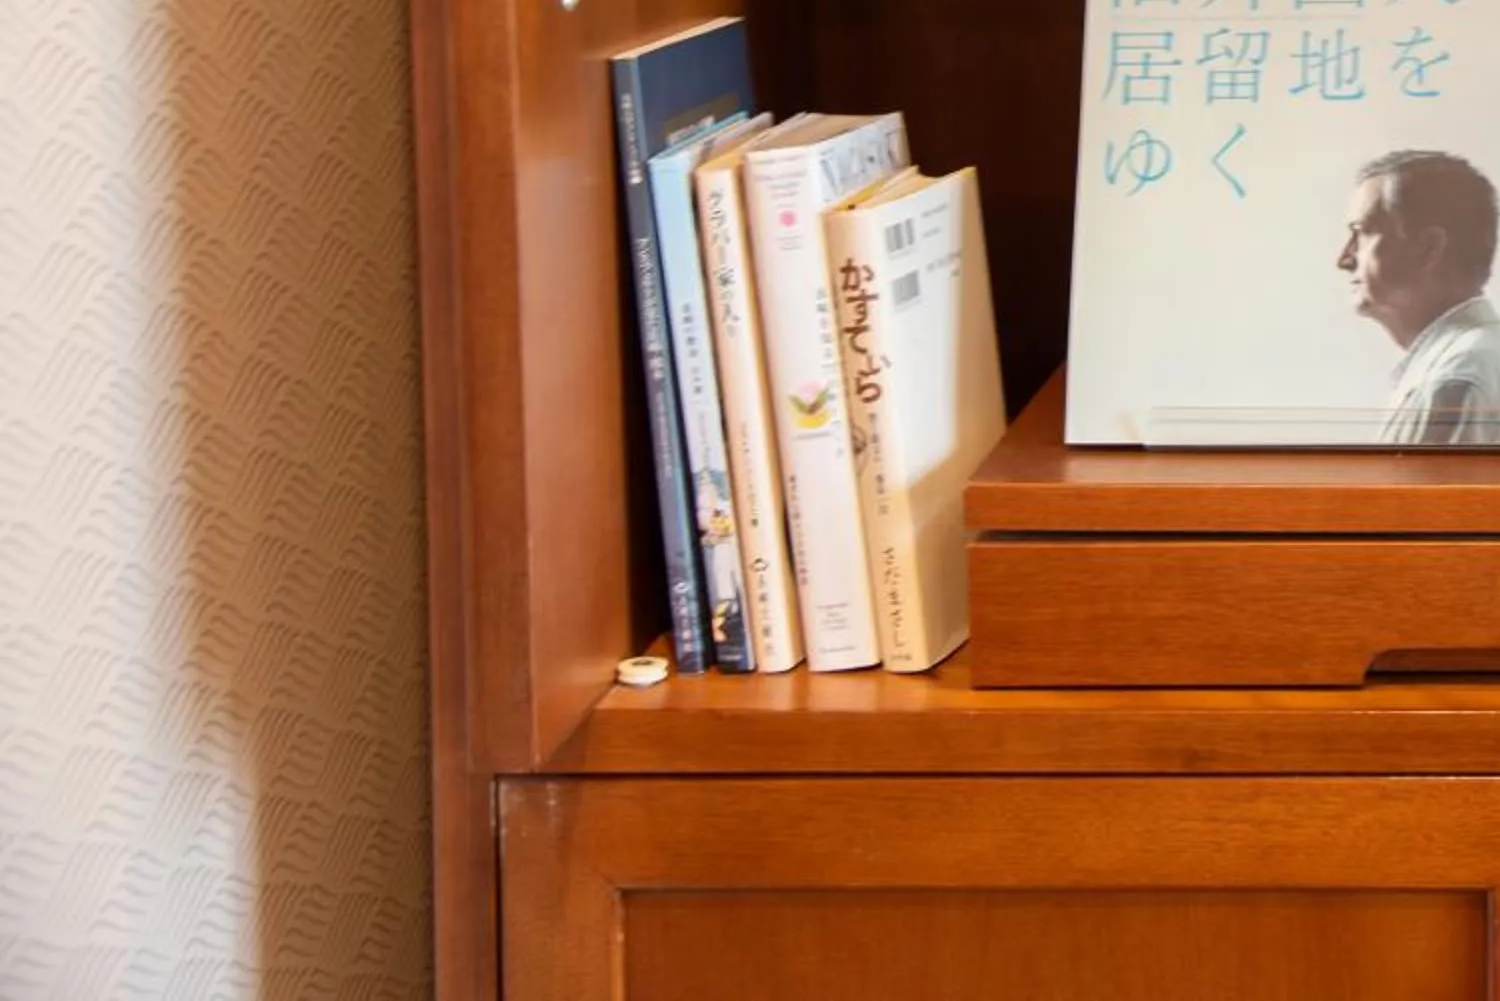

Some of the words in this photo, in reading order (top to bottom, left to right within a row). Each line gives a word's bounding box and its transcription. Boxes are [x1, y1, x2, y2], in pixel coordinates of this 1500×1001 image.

[1102, 25, 1451, 107] 居留地を
[1103, 122, 1248, 199] ゆく
